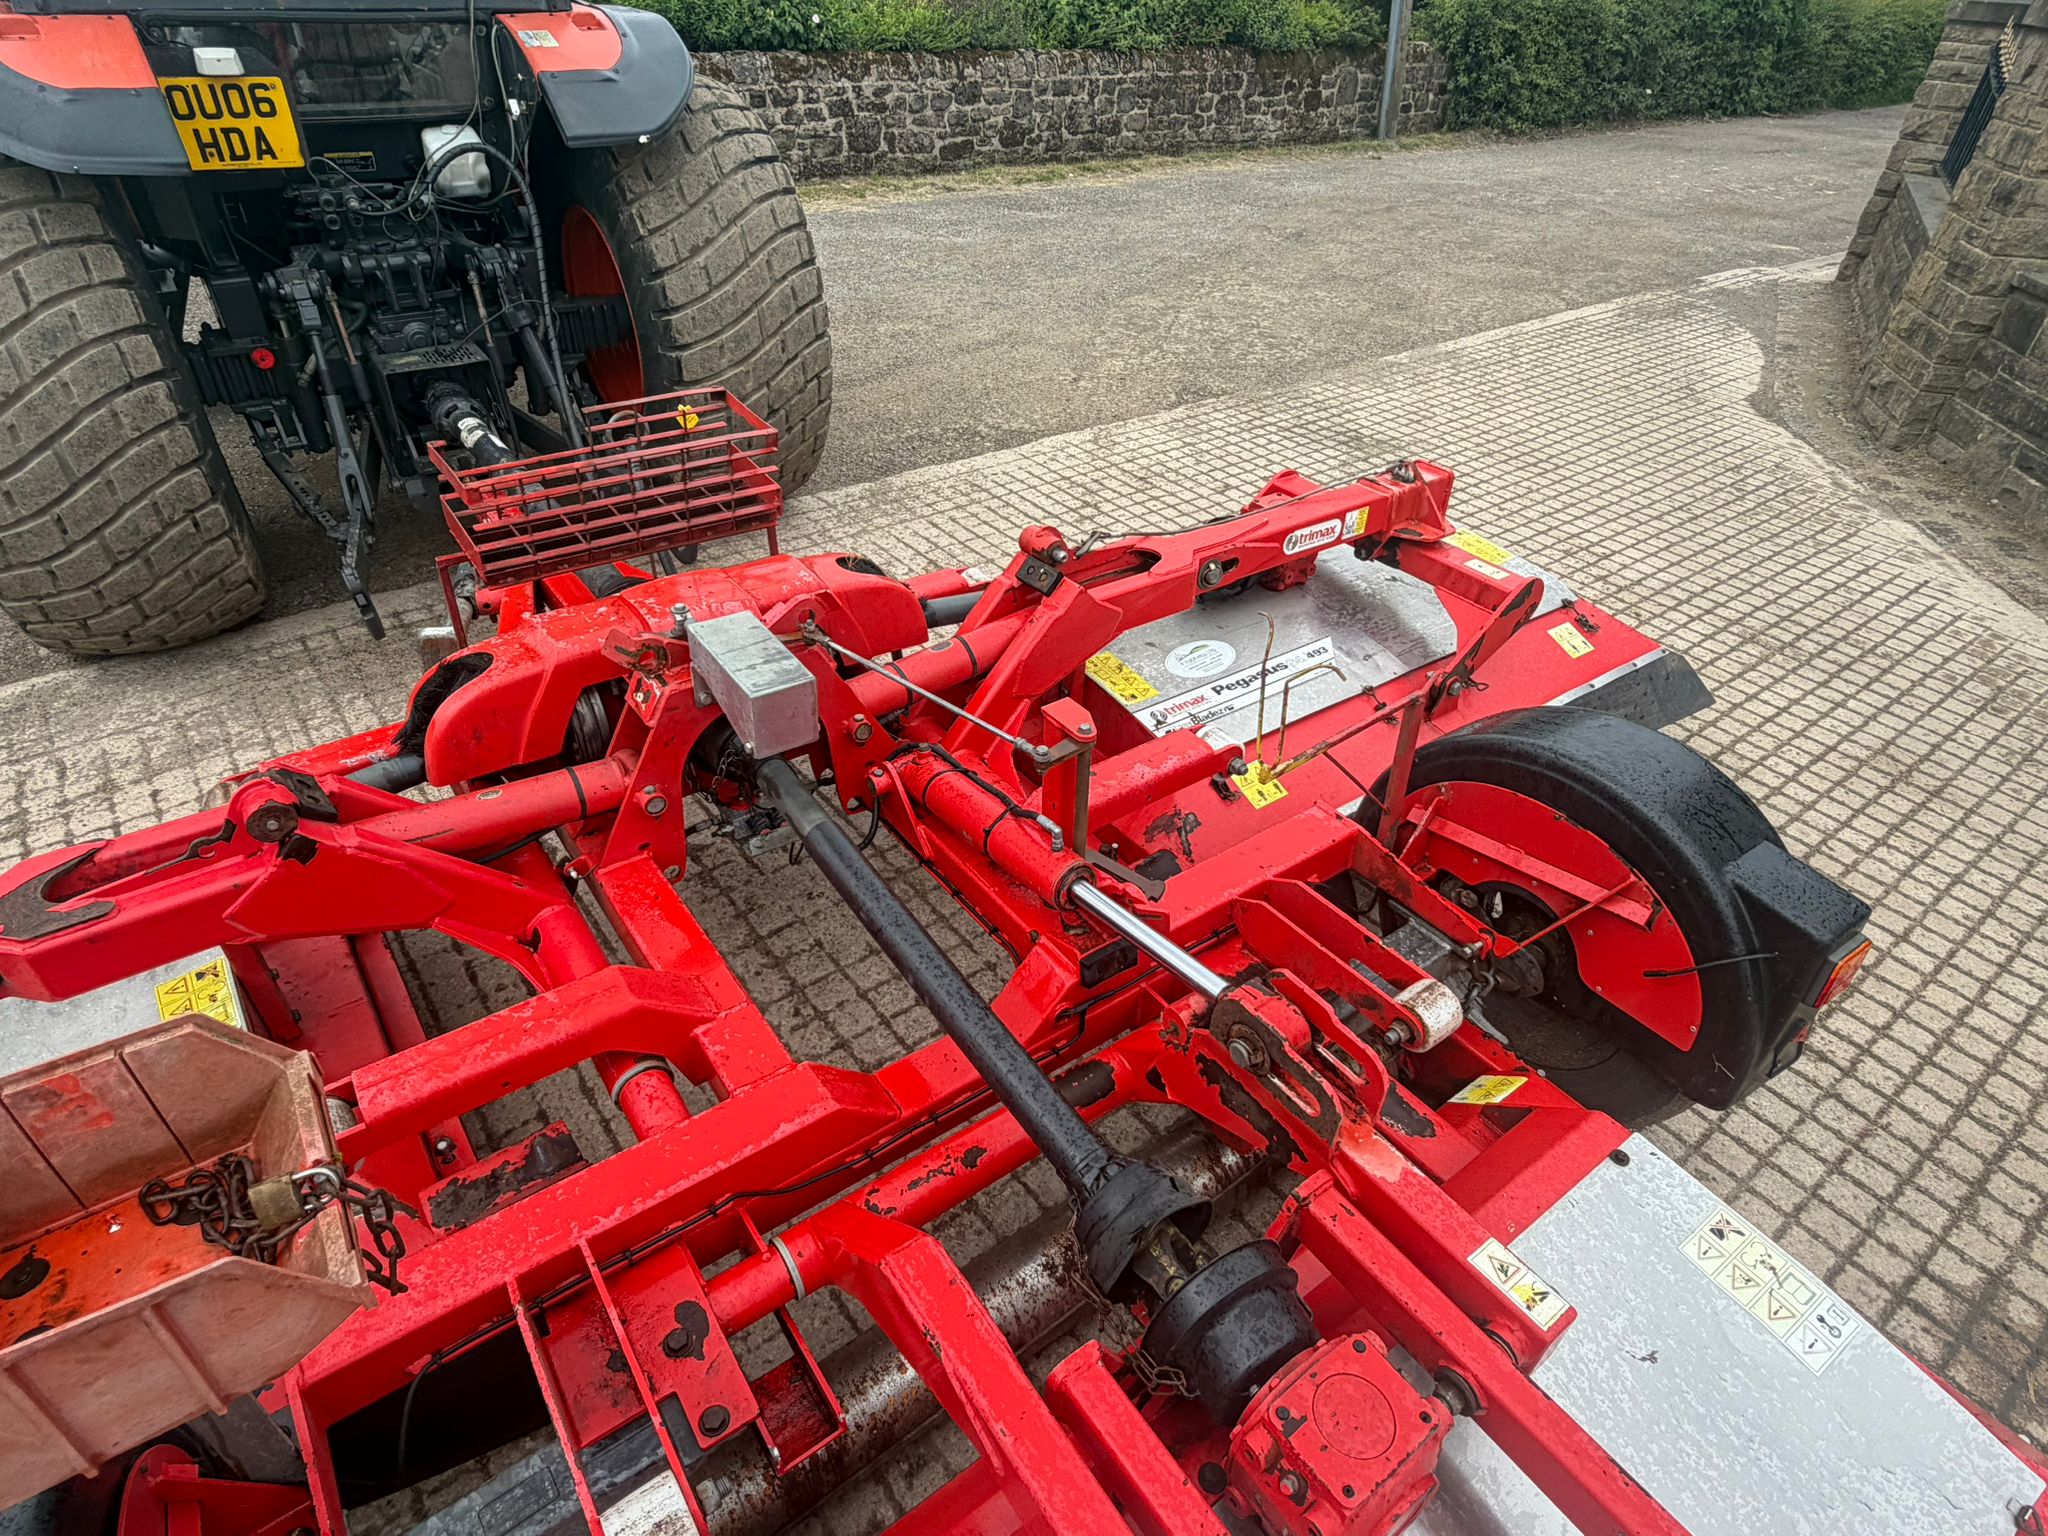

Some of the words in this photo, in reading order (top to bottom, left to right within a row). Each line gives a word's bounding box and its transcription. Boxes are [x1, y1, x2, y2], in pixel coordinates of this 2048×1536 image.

[165, 83, 278, 120] OU06
[192, 126, 279, 163] HDA
[1299, 524, 1338, 544] trimax
[1163, 694, 1208, 715] trimax
[1210, 662, 1289, 695] Pegasus
[1306, 646, 1329, 659] 493
